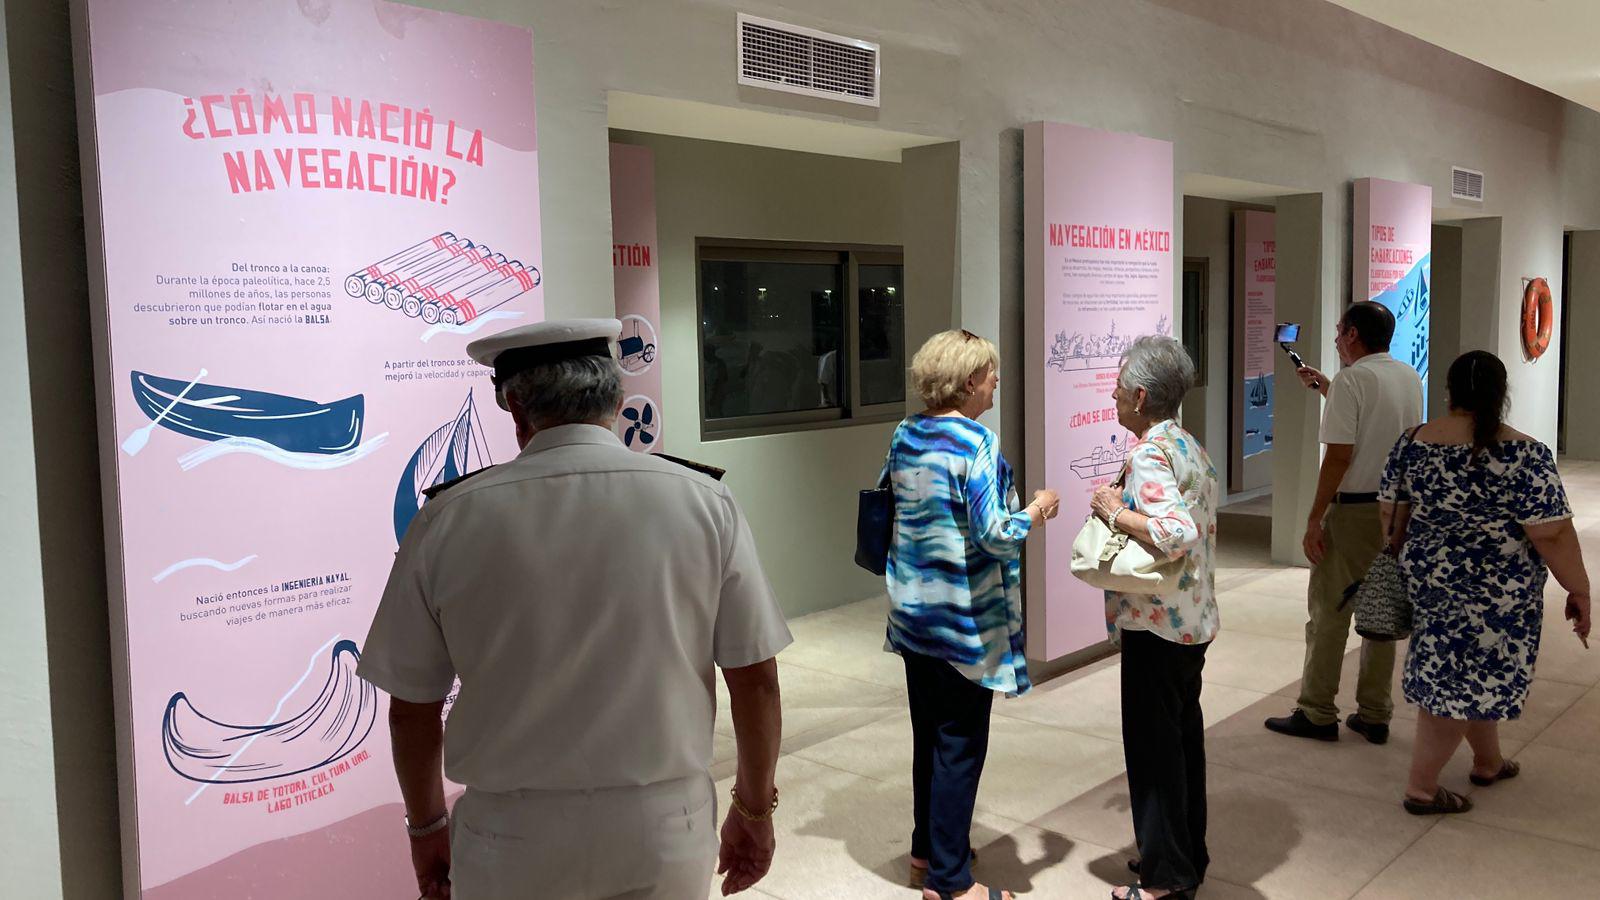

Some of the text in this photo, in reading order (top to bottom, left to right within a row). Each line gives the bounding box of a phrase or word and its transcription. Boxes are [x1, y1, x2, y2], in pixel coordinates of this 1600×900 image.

[182, 88, 484, 167] ¿CÓMO NACIÓ LA
[223, 148, 457, 205] NAVEGACIÓN?
[1049, 223, 1170, 252] NAVEGACIÓN EN MÉXICO
[1371, 225, 1394, 242] TIPOS DE
[1371, 247, 1413, 264] EMBARCACIONES
[232, 263, 248, 272] Del
[250, 264, 280, 272] tronco
[290, 264, 299, 273] la
[301, 265, 330, 273] canoa:
[156, 275, 331, 288] Durante la época paleolítica, hace 2,5
[189, 289, 331, 300] millones de años, las personas
[133, 302, 332, 315] descubrieron que podían flotar en el agua
[169, 316, 197, 325] sobre
[200, 317, 213, 325] un
[215, 316, 249, 324] tronco.
[251, 315, 266, 324] Así
[268, 315, 292, 324] nació
[294, 315, 302, 324] la
[384, 361, 390, 369] A
[392, 360, 415, 370] partir
[385, 368, 494, 382] mejoró la velocidad y capacid
[1069, 407, 1115, 428] ¿CÓMO SE DICE
[196, 592, 224, 606] Nació
[226, 585, 268, 601] entonces
[270, 584, 279, 592] la
[281, 576, 323, 592] INGENIERÍA
[180, 584, 352, 622] buscando nuevas formas para realizar
[226, 614, 253, 626] viajes
[255, 611, 266, 621] de
[269, 606, 303, 618] manera
[305, 600, 324, 611] más
[223, 791, 254, 804] BALSA
[257, 789, 269, 801] DE
[312, 762, 351, 786] CULTURA
[268, 783, 335, 813] LAGO TITICACA
